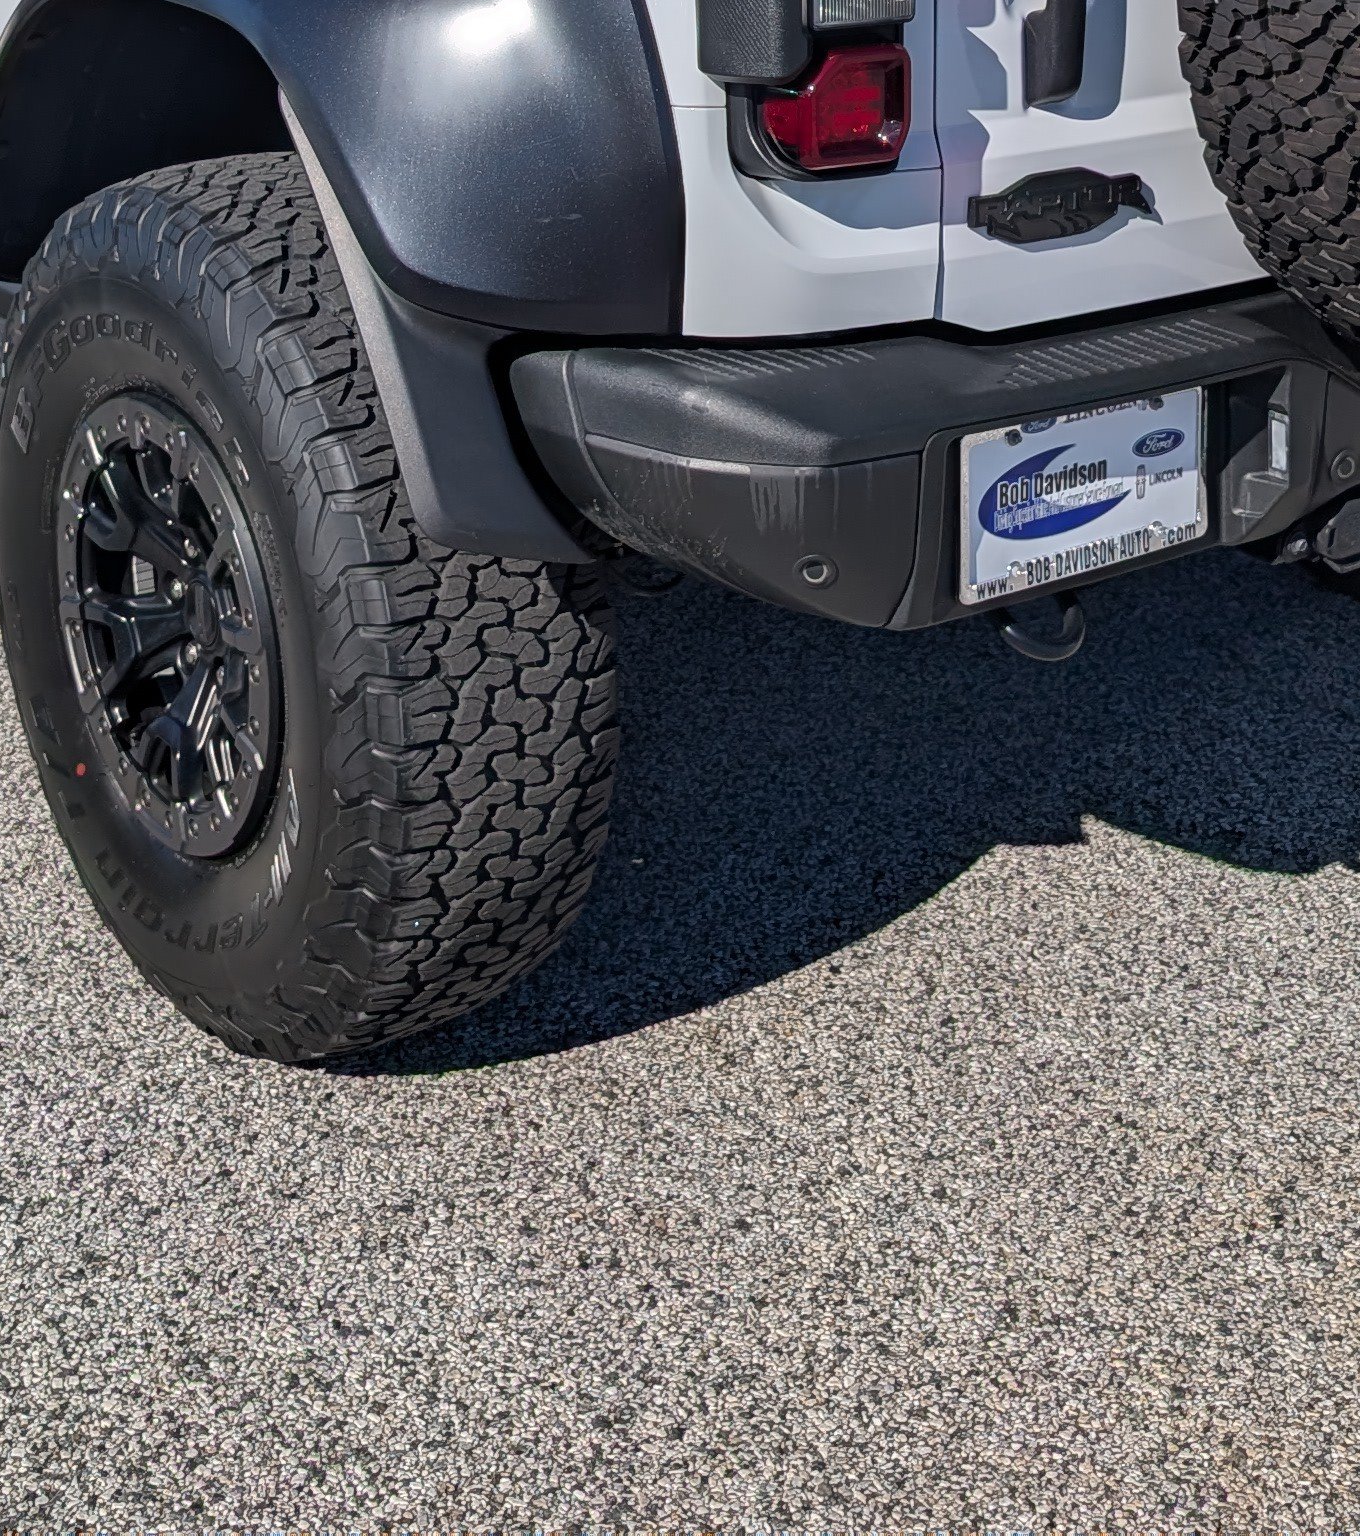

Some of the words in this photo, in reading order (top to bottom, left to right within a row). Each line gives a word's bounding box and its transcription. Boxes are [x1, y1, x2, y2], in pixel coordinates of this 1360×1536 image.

[10, 310, 252, 490] BFGoodrich
[998, 473, 1030, 511] Bob
[1033, 458, 1109, 500] Davidson
[1148, 466, 1184, 487] LINCOLN
[1025, 560, 1051, 586] BOB
[1055, 542, 1116, 578] DAVIDSON
[1119, 528, 1151, 559] AUTO
